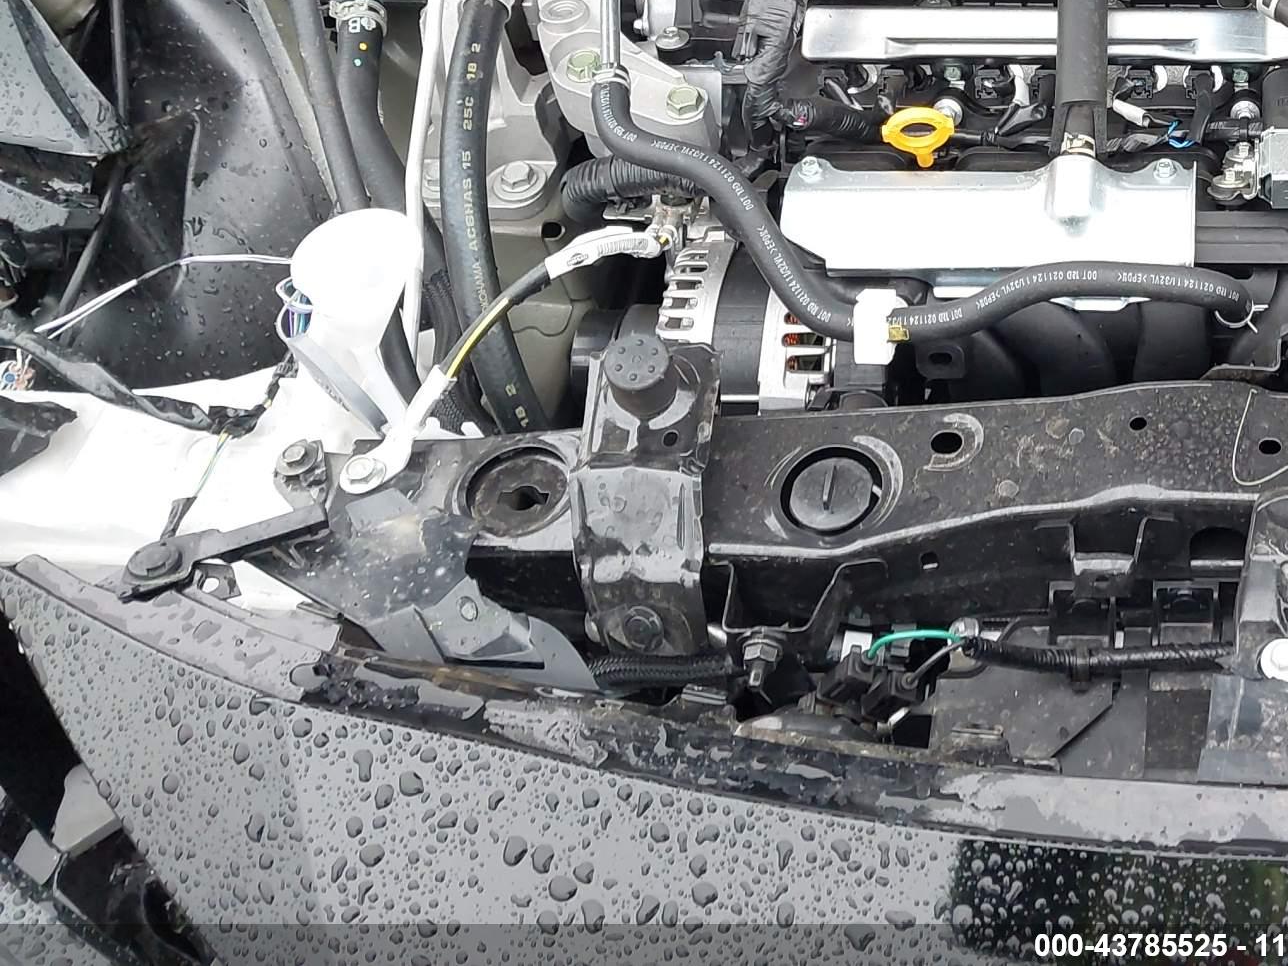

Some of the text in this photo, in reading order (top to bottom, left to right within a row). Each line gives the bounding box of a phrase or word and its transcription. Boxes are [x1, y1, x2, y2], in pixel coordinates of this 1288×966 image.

[463, 96, 474, 131] 25C
[462, 150, 472, 169] 15
[1031, 271, 1064, 283] 021124
[1081, 270, 1097, 278] DOT
